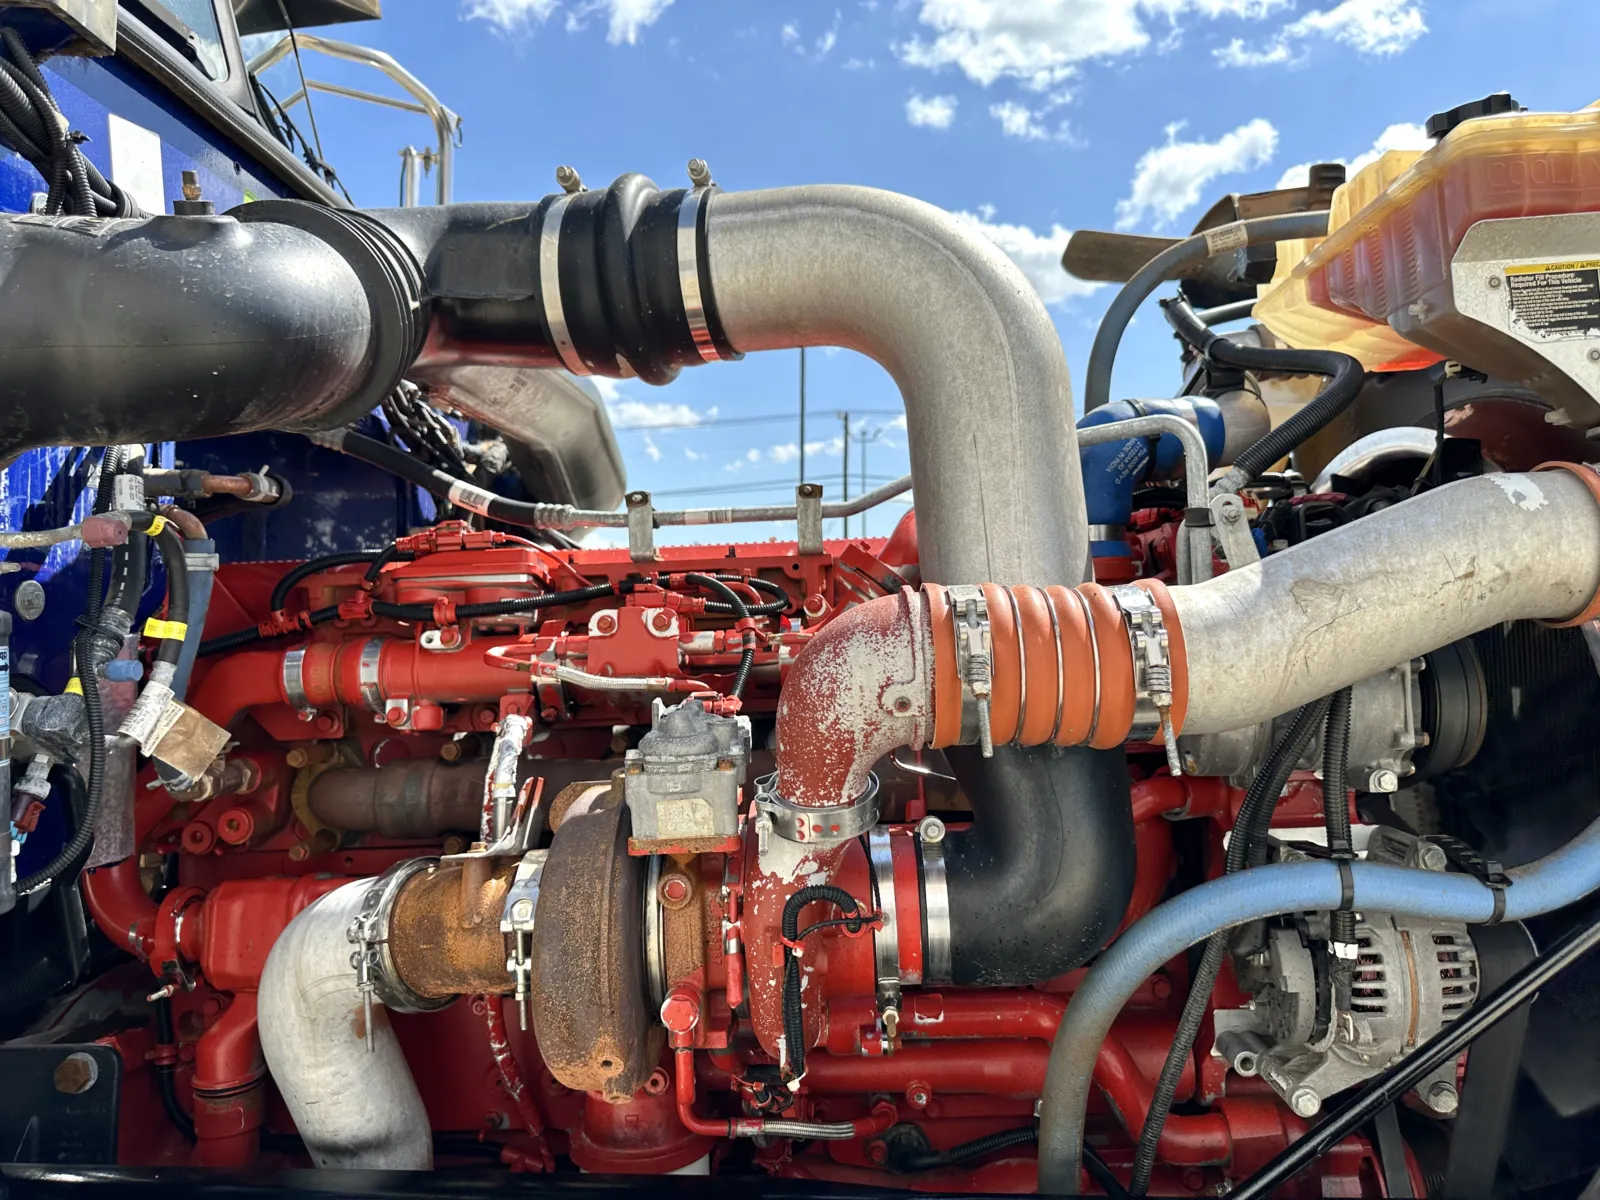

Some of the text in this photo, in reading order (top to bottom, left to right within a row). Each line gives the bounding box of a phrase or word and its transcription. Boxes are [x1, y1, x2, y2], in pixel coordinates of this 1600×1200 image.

[1511, 280, 1536, 288] Required
[1122, 437, 1137, 453] MADE
[1105, 458, 1120, 472] INDIA
